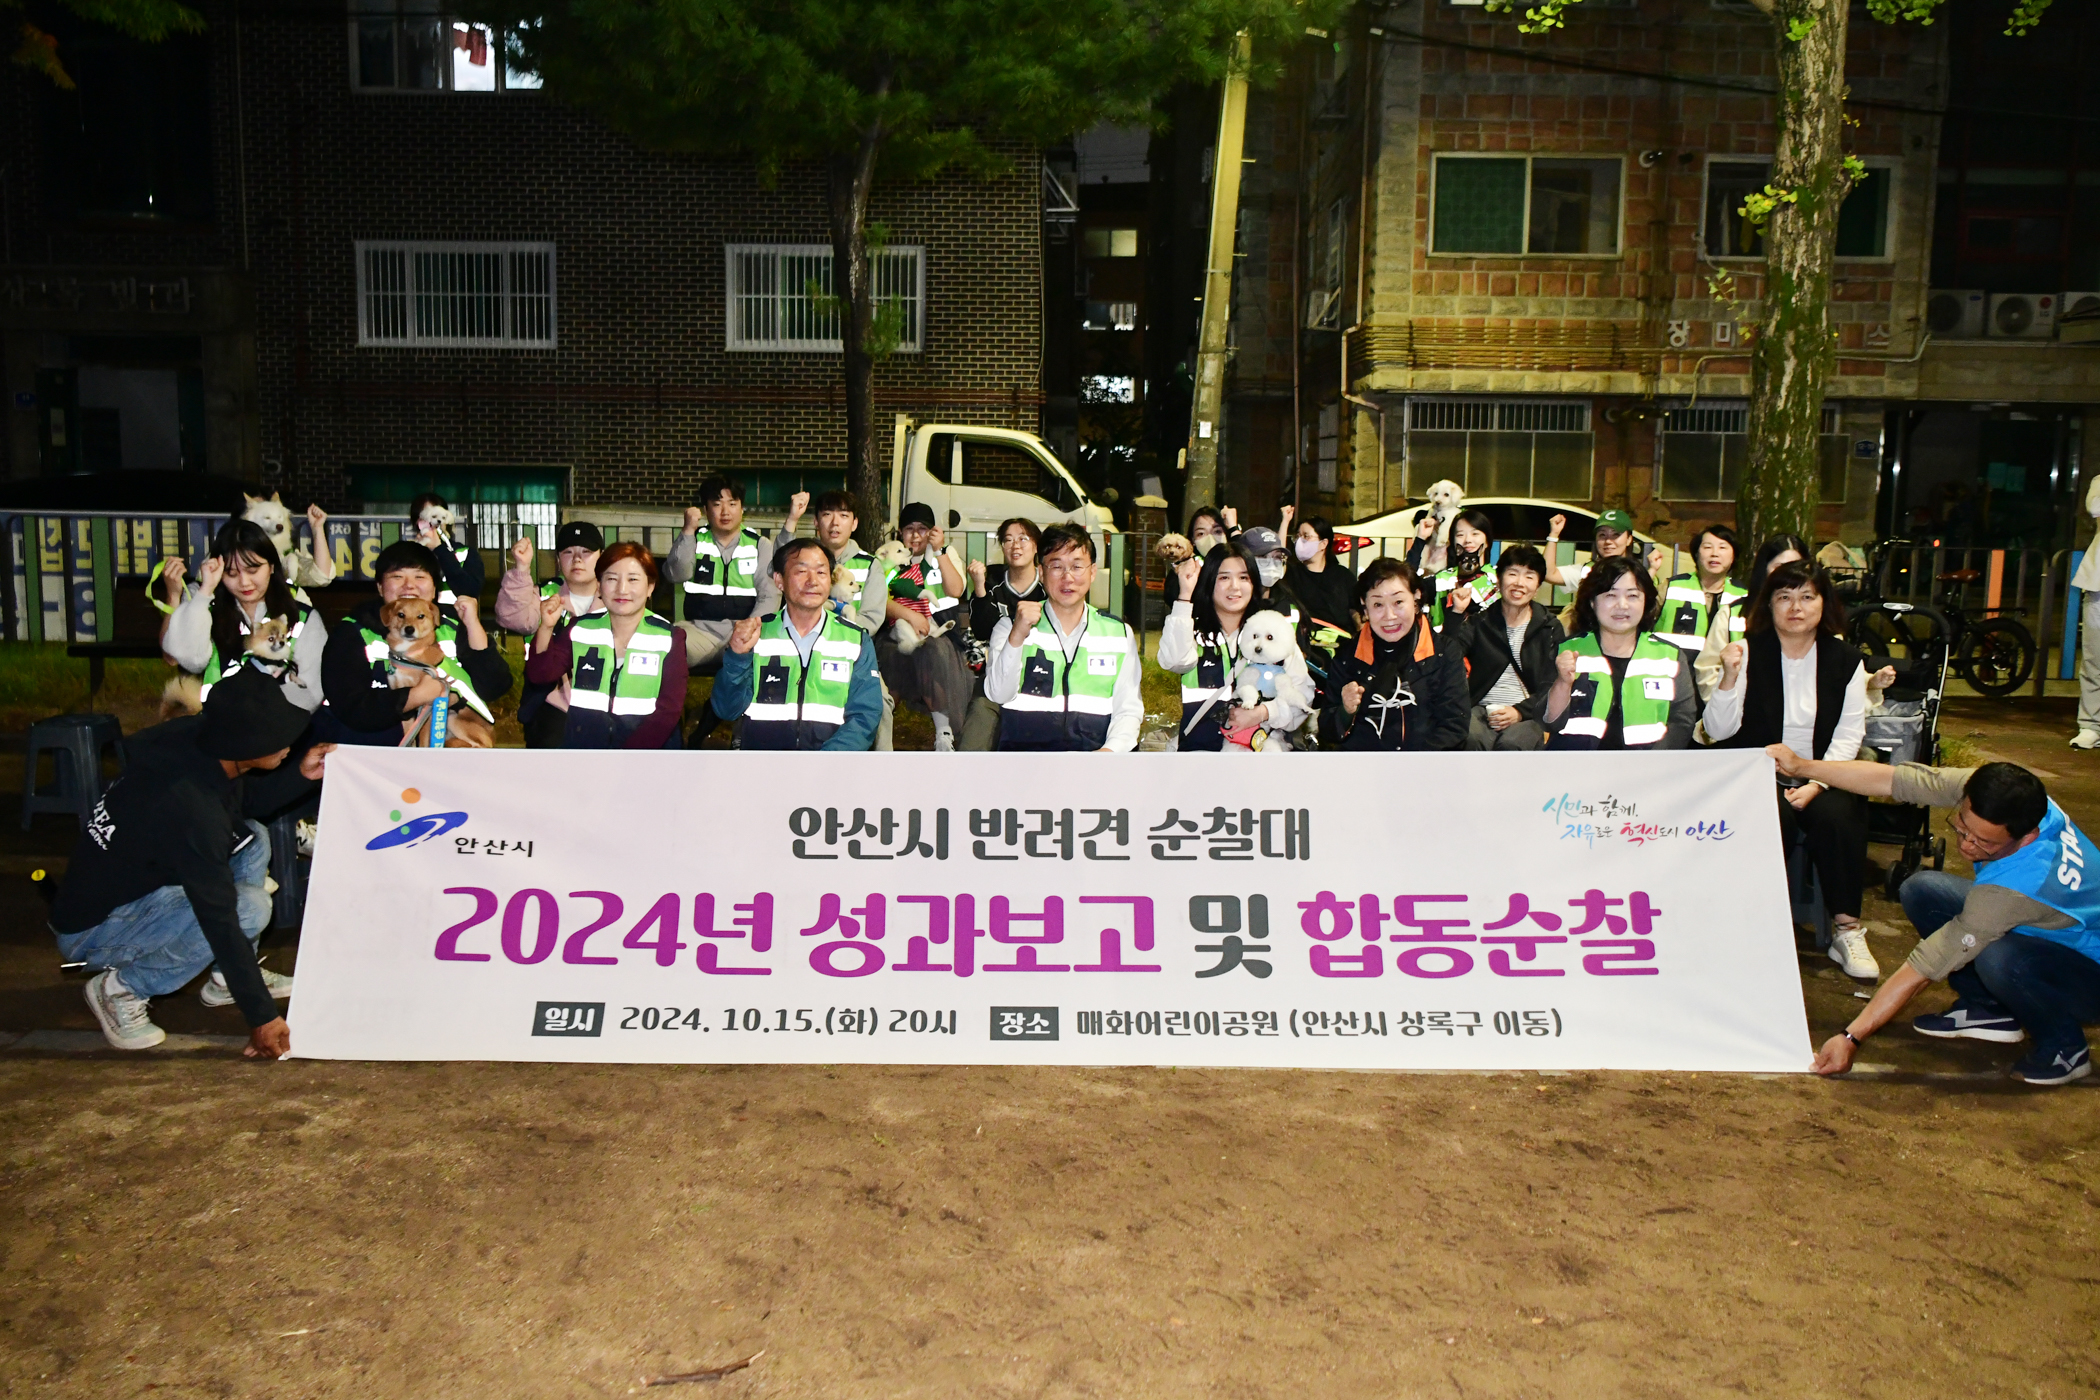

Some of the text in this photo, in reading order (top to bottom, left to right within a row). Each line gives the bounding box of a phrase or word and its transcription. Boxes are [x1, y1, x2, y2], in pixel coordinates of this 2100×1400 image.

[1604, 511, 1617, 521] C
[1542, 792, 1597, 825] 시민과
[453, 836, 535, 858] 안산시
[788, 806, 1310, 861] 안산시 반려견 순찰대
[1559, 819, 1736, 850] 자유로운 혁신도시 안산
[433, 886, 1663, 979] 2024년 성과보고 및 합동순찰
[543, 1006, 957, 1036] 일시 2024. 10.15.(화) 20시
[998, 1007, 1563, 1038] 장소 매화어린이공원 (안산시 상록구 이동)
